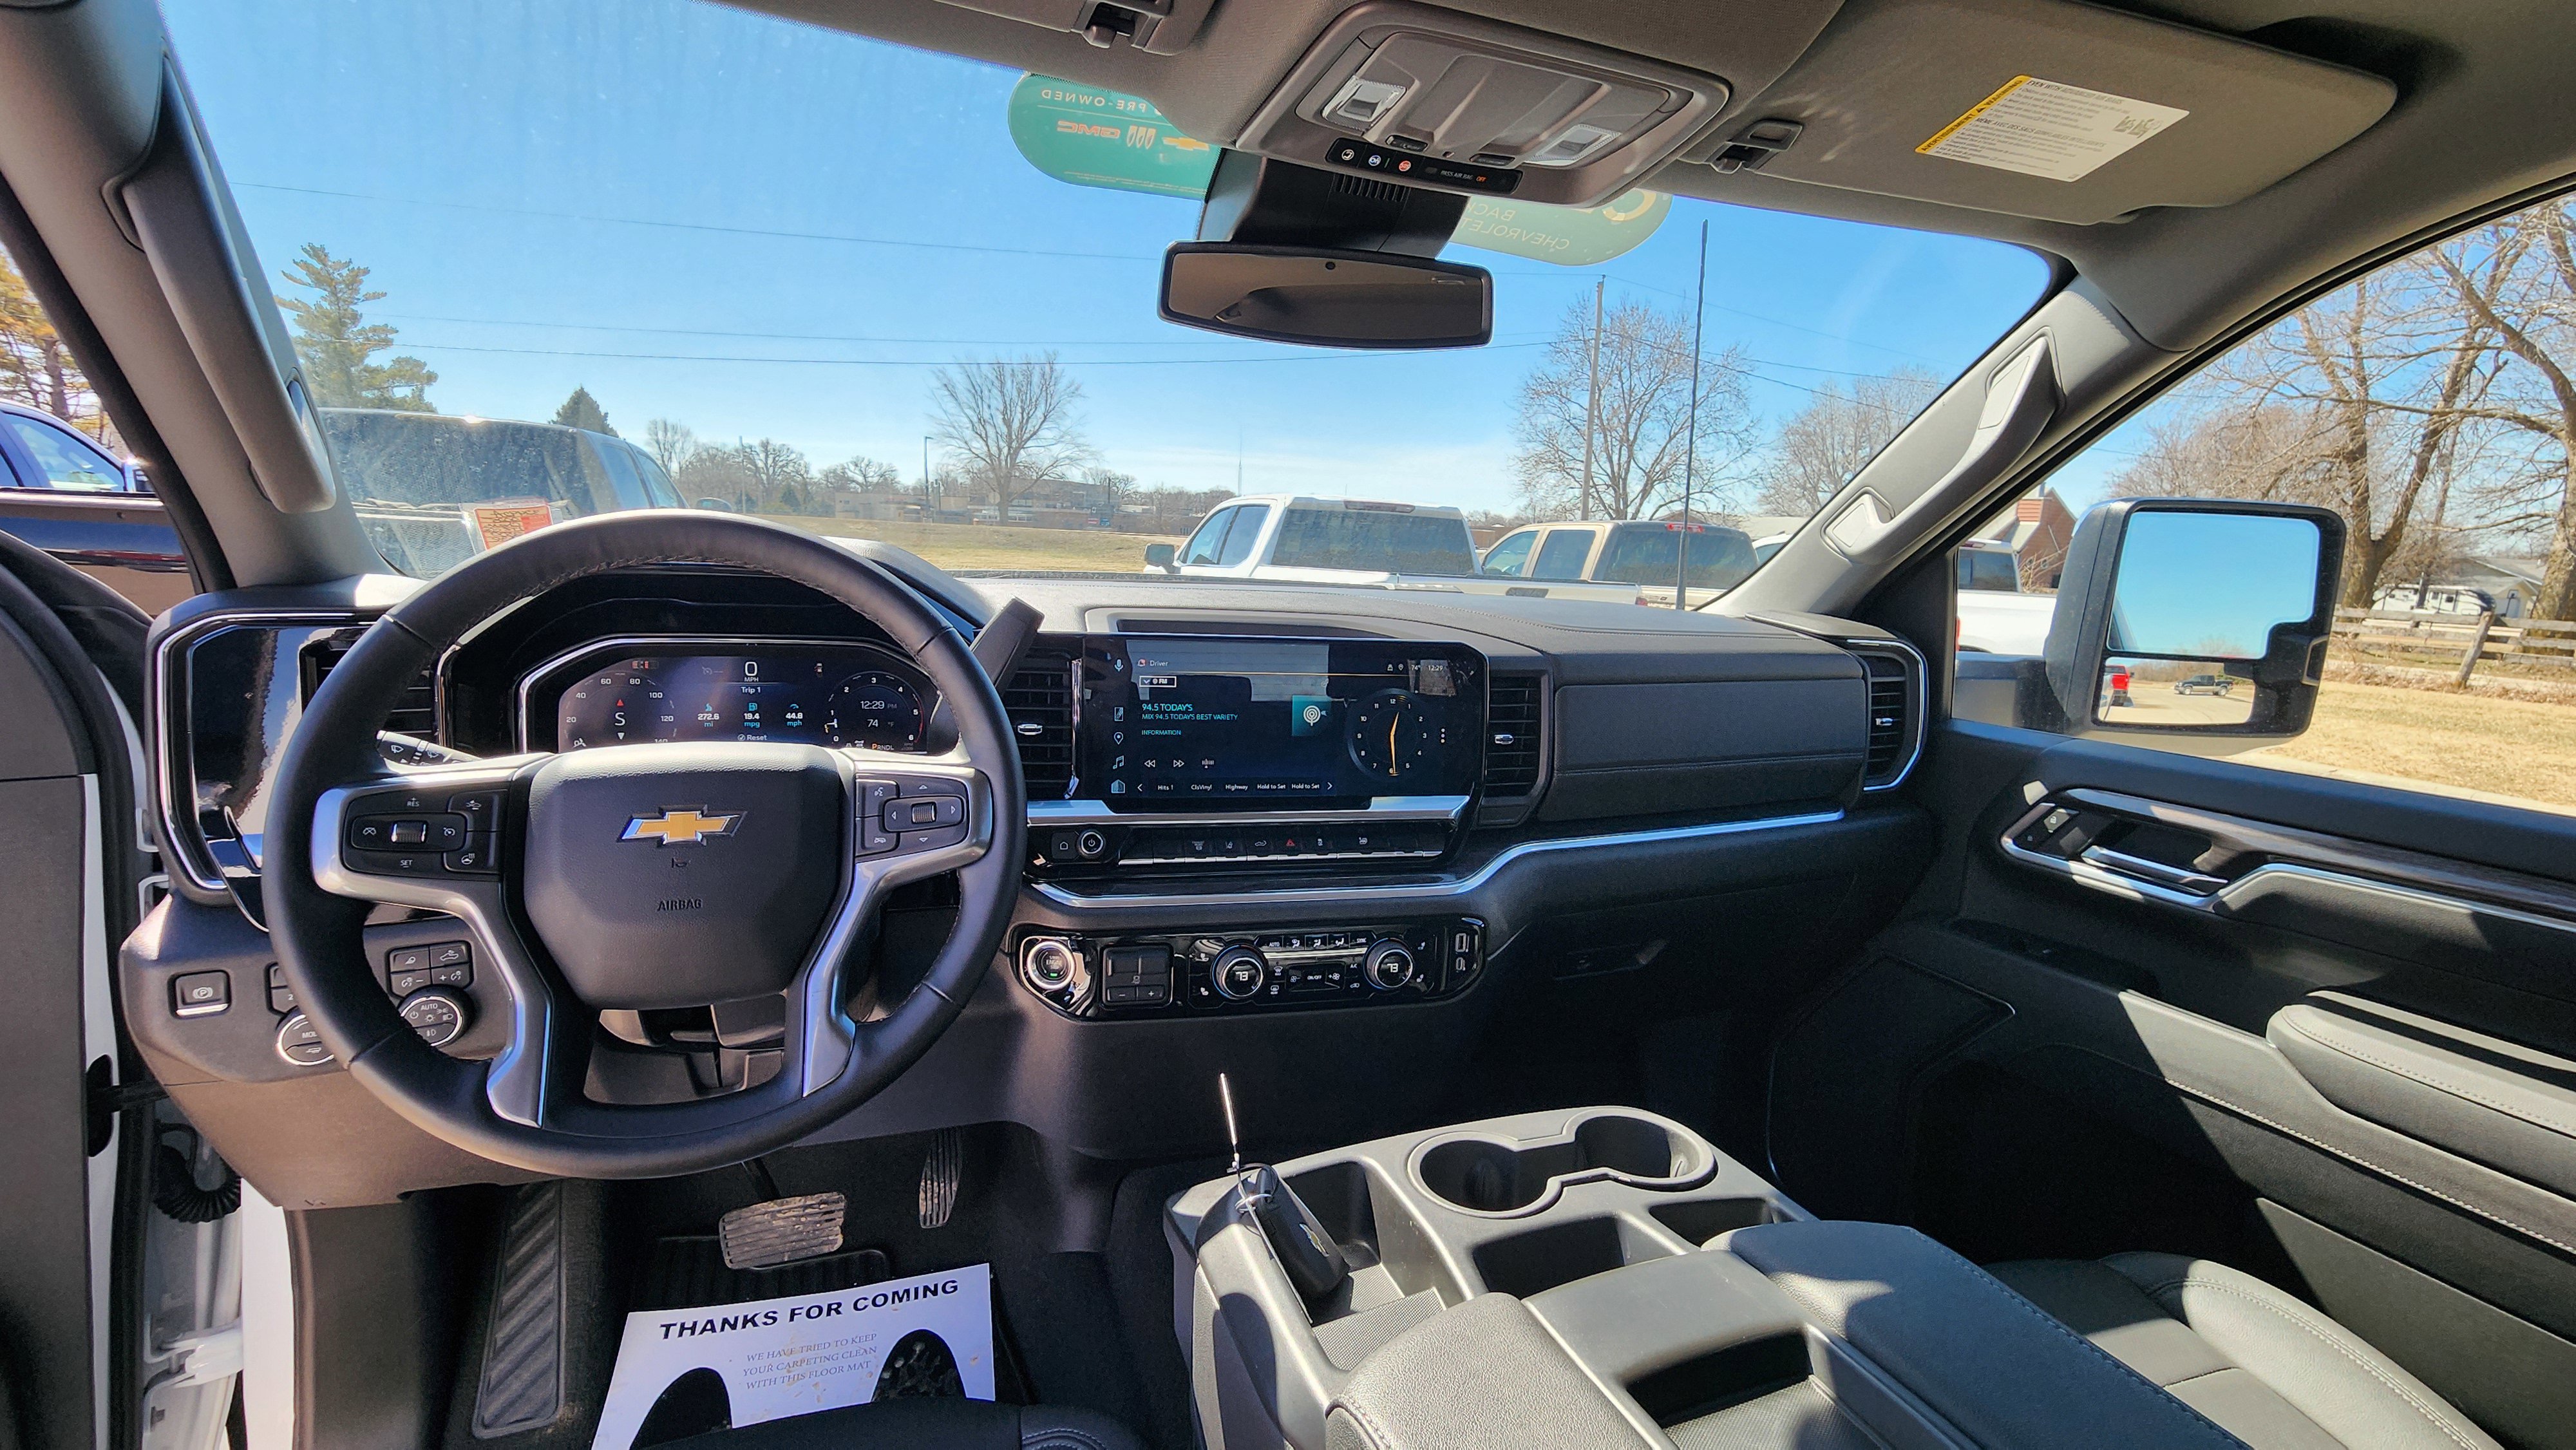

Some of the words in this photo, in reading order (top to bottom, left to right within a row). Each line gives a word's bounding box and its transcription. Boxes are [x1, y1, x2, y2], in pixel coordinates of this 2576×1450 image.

[744, 661, 758, 676] 0
[860, 701, 885, 710] 12:29
[1160, 703, 1193, 711] TODAY'S
[614, 712, 626, 726] S
[867, 719, 878, 728] 74
[657, 898, 703, 912] AIRBAG
[1387, 963, 1399, 972] 73
[1236, 972, 1248, 981] 73
[659, 1310, 778, 1340] THANKS
[789, 1301, 843, 1323] FOR
[852, 1279, 960, 1312] COMING
[747, 1352, 764, 1362] WE
[767, 1347, 796, 1359] HAVE
[799, 1342, 831, 1353] TRIED
[834, 1338, 849, 1348] TO
[851, 1333, 877, 1344] KEEP
[743, 1364, 773, 1377] YOUR
[776, 1353, 839, 1371] CARPETING
[841, 1346, 877, 1359] CLEAN
[746, 1378, 777, 1389] WITH
[780, 1372, 806, 1384] THIS
[809, 1366, 844, 1379] FLOOR
[846, 1361, 872, 1372] MAT
